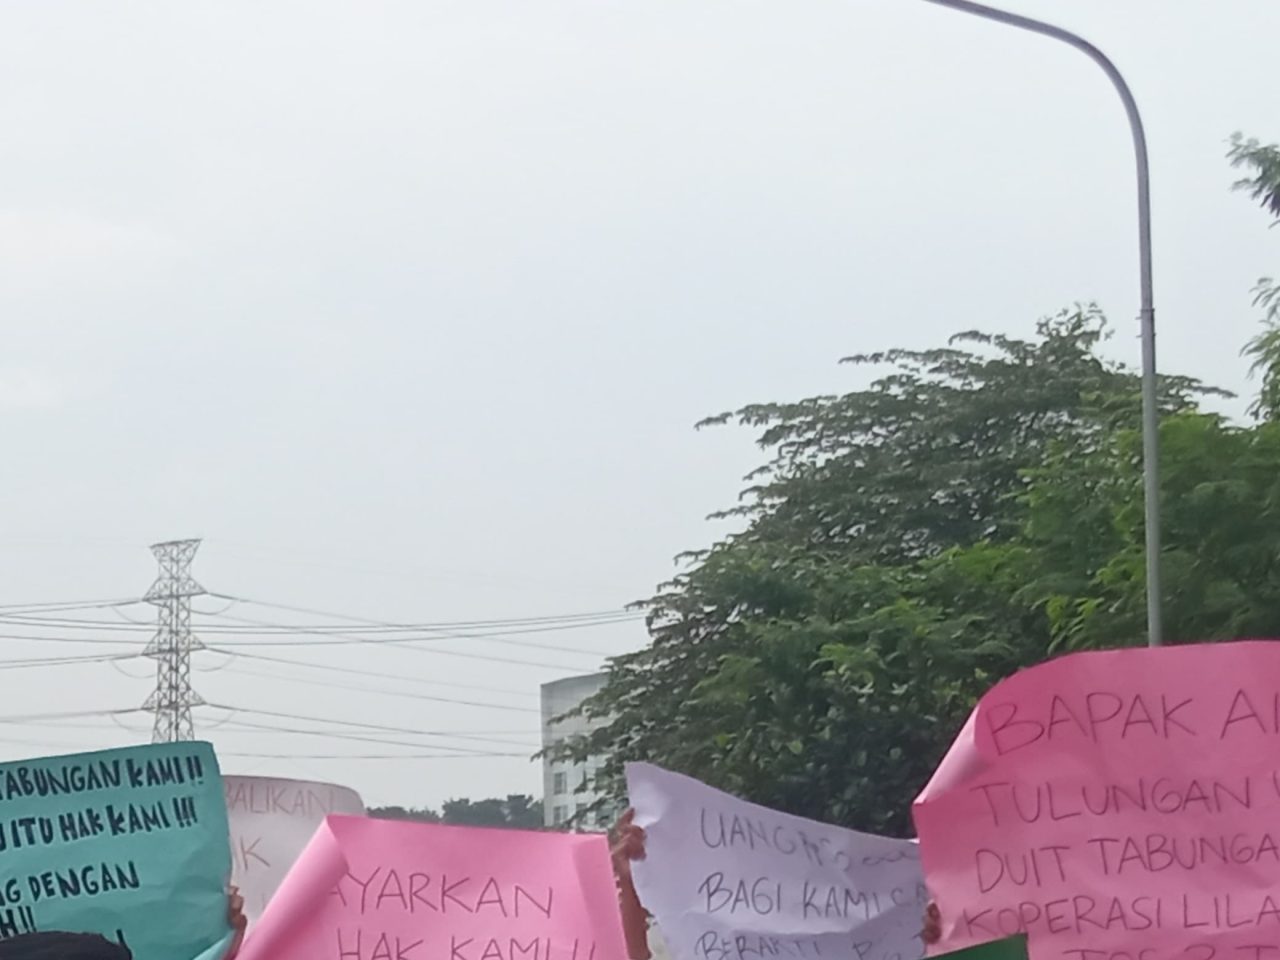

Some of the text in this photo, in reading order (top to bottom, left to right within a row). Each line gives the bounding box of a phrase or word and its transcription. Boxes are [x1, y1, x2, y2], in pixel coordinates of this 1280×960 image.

[985, 688, 1280, 757] BAPAK AI
[226, 783, 334, 819] BALIKAN
[970, 776, 1251, 827] TULUNGAN
[10, 815, 54, 849] ITU
[58, 808, 105, 843] HAK
[29, 860, 141, 900] DENGAN
[975, 845, 1072, 894] DUIT
[1087, 832, 1280, 875] TABUNGA
[698, 872, 783, 916] BAGI
[802, 880, 881, 921] KAMI
[962, 895, 1162, 939] KOPERASI
